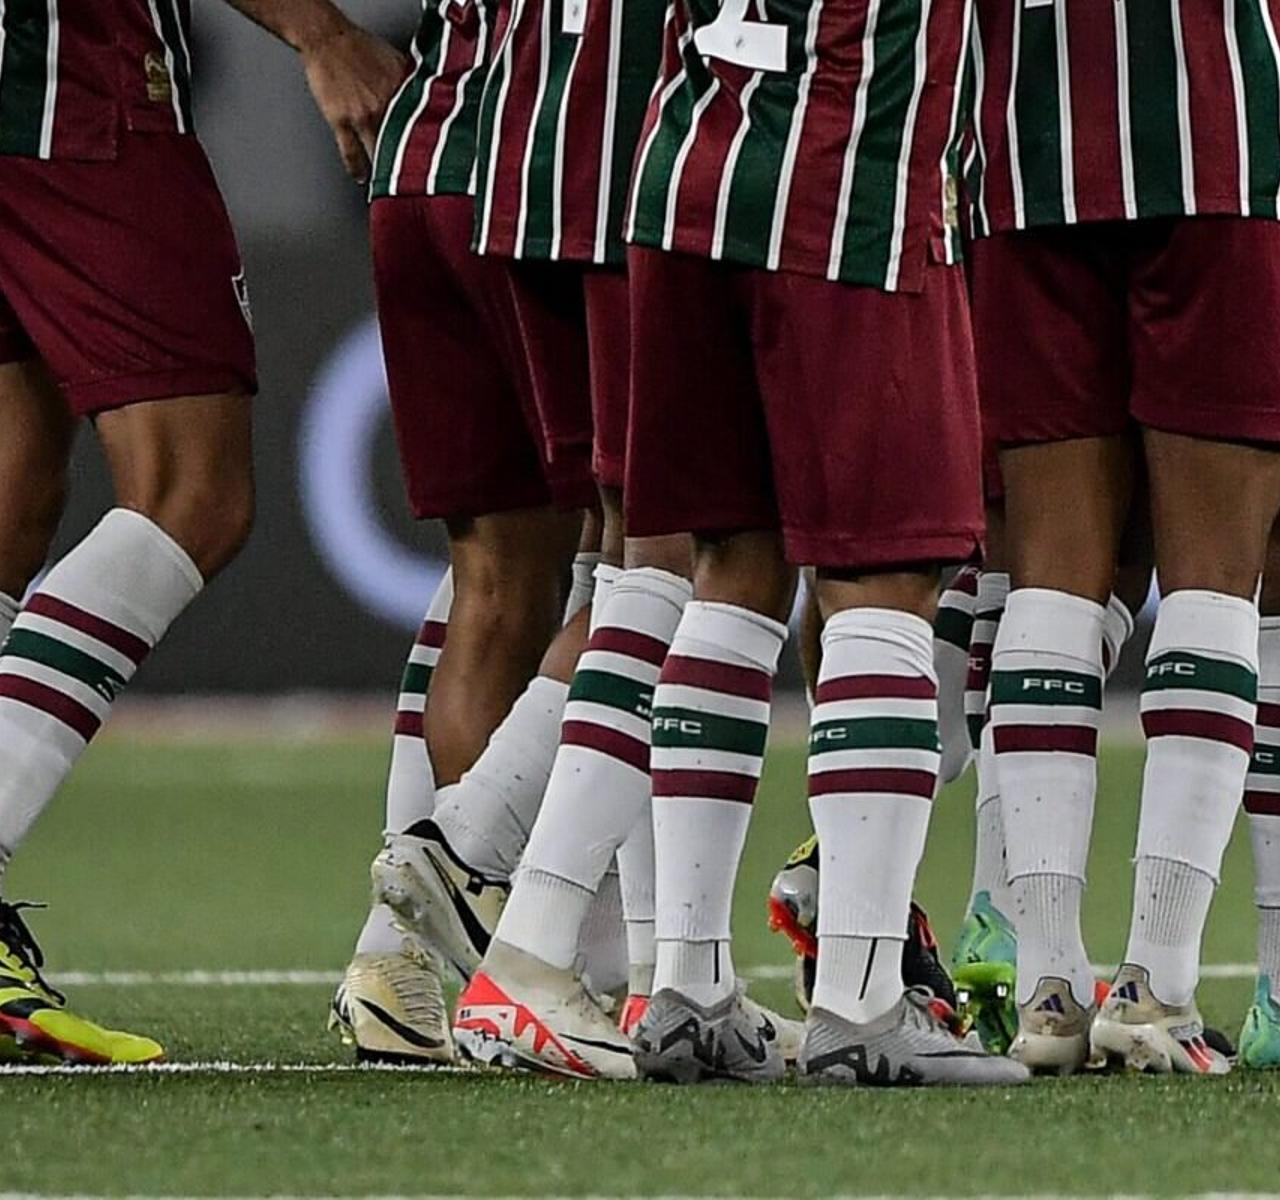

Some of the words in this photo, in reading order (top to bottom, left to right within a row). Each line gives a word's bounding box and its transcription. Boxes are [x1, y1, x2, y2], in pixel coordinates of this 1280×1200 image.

[1146, 661, 1197, 679] FFC
[1022, 676, 1085, 695] FFC
[651, 716, 703, 736] FFC
